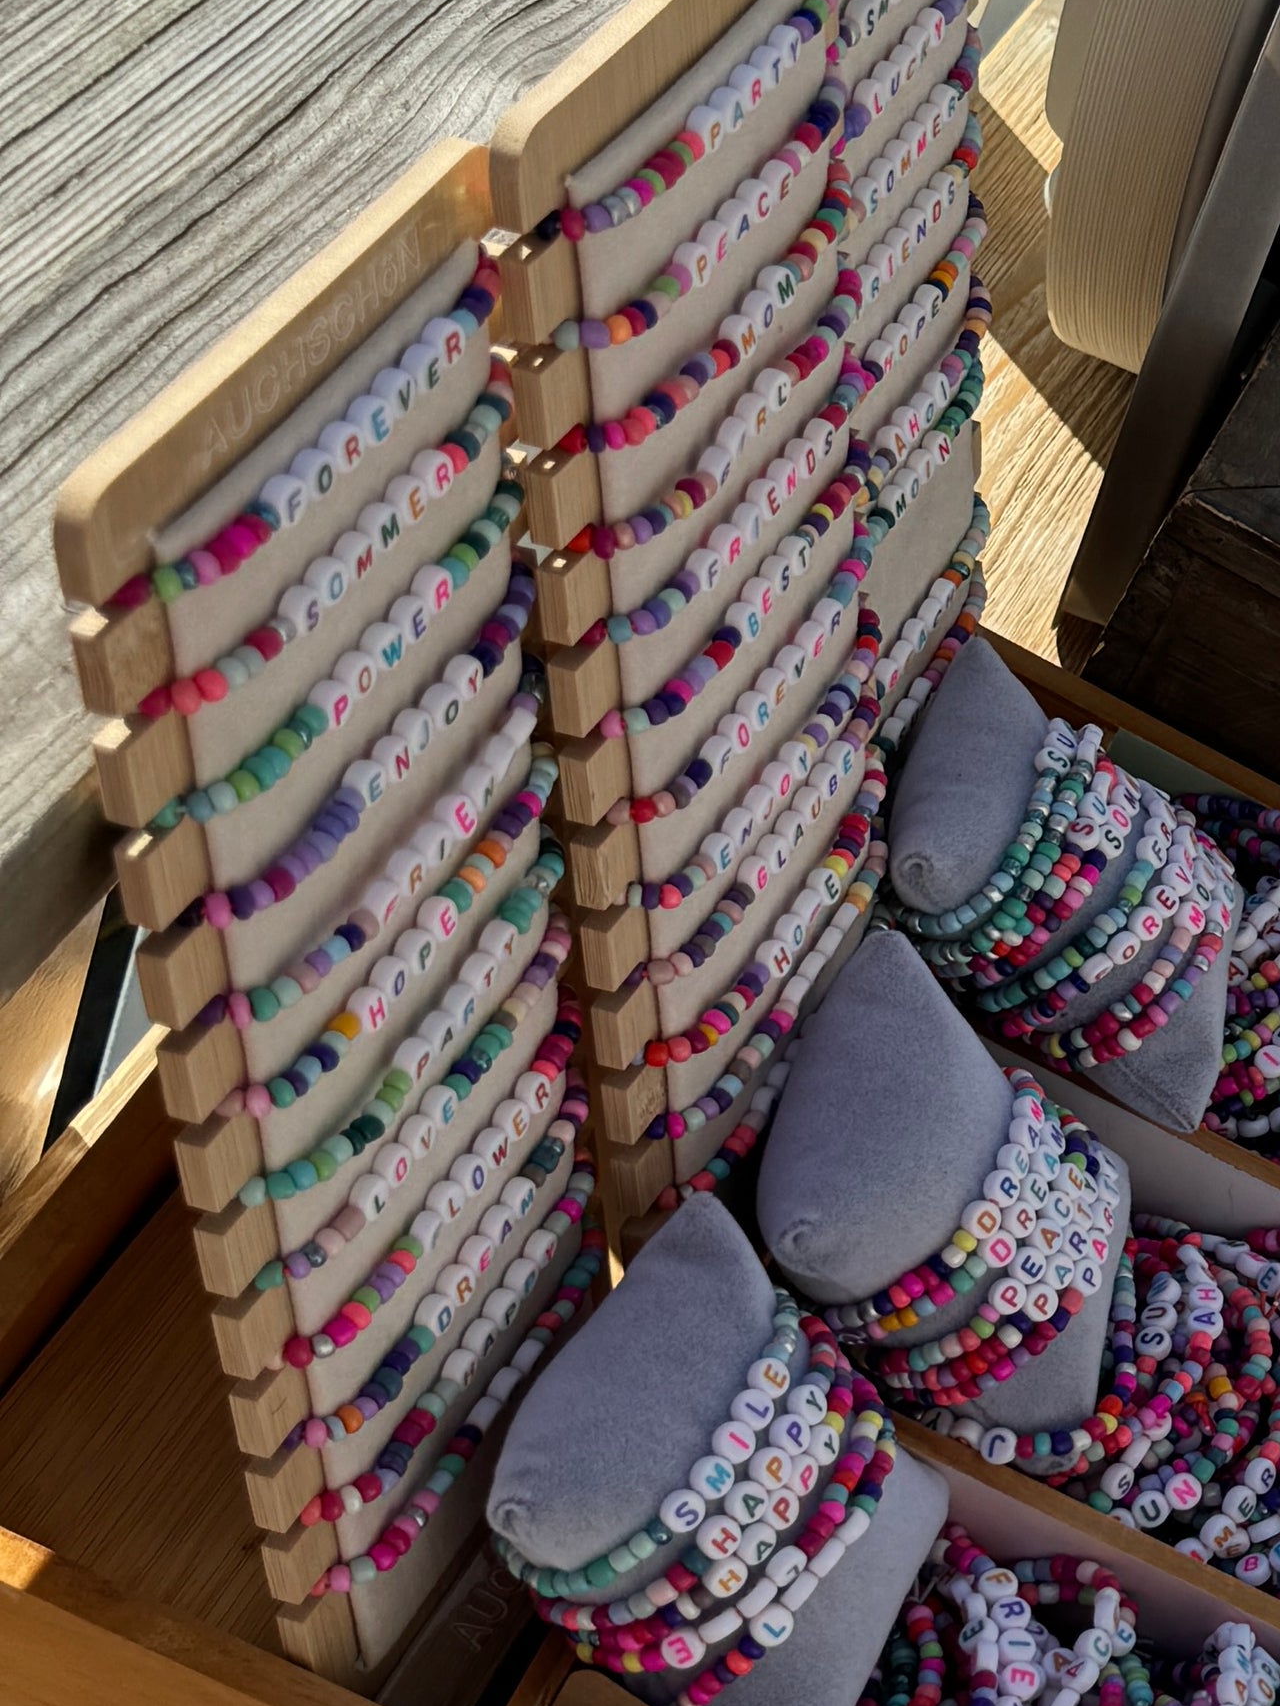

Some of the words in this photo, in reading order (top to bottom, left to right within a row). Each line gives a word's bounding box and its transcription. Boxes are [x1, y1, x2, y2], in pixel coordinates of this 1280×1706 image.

[710, 41, 800, 151] PARTY
[872, 16, 943, 116] LUCKY
[869, 96, 957, 215] SOMMER
[696, 172, 792, 282] PEACE
[871, 180, 955, 298] RIENDS
[740, 272, 795, 351] MOM
[883, 294, 941, 373] HOPE
[287, 331, 462, 523] FOREVER
[894, 380, 948, 459] AHOI
[896, 437, 950, 519] MOIN
[307, 462, 451, 632] SOMMER
[707, 429, 833, 589] FRIENDS
[332, 578, 450, 726] POWER
[748, 544, 809, 638] BEST
[369, 669, 479, 803] ENJOY
[720, 610, 841, 774] FOREVER
[720, 750, 809, 870] ENJOY
[756, 748, 853, 890] GLAUBE
[368, 905, 456, 1029] HOPE
[414, 933, 515, 1081] PARTY
[373, 1097, 455, 1215] LOVE
[976, 1098, 1044, 1234] DREAM
[989, 1123, 1065, 1263] DREAM
[1082, 1153, 1117, 1288] PARTY
[436, 1187, 535, 1334] DREAM
[1000, 1167, 1084, 1308] PEACE
[1033, 1173, 1096, 1316] PARTY
[674, 1363, 788, 1527] SMILE
[711, 1389, 824, 1556] HAPPY
[717, 1433, 837, 1592] HAPPY
